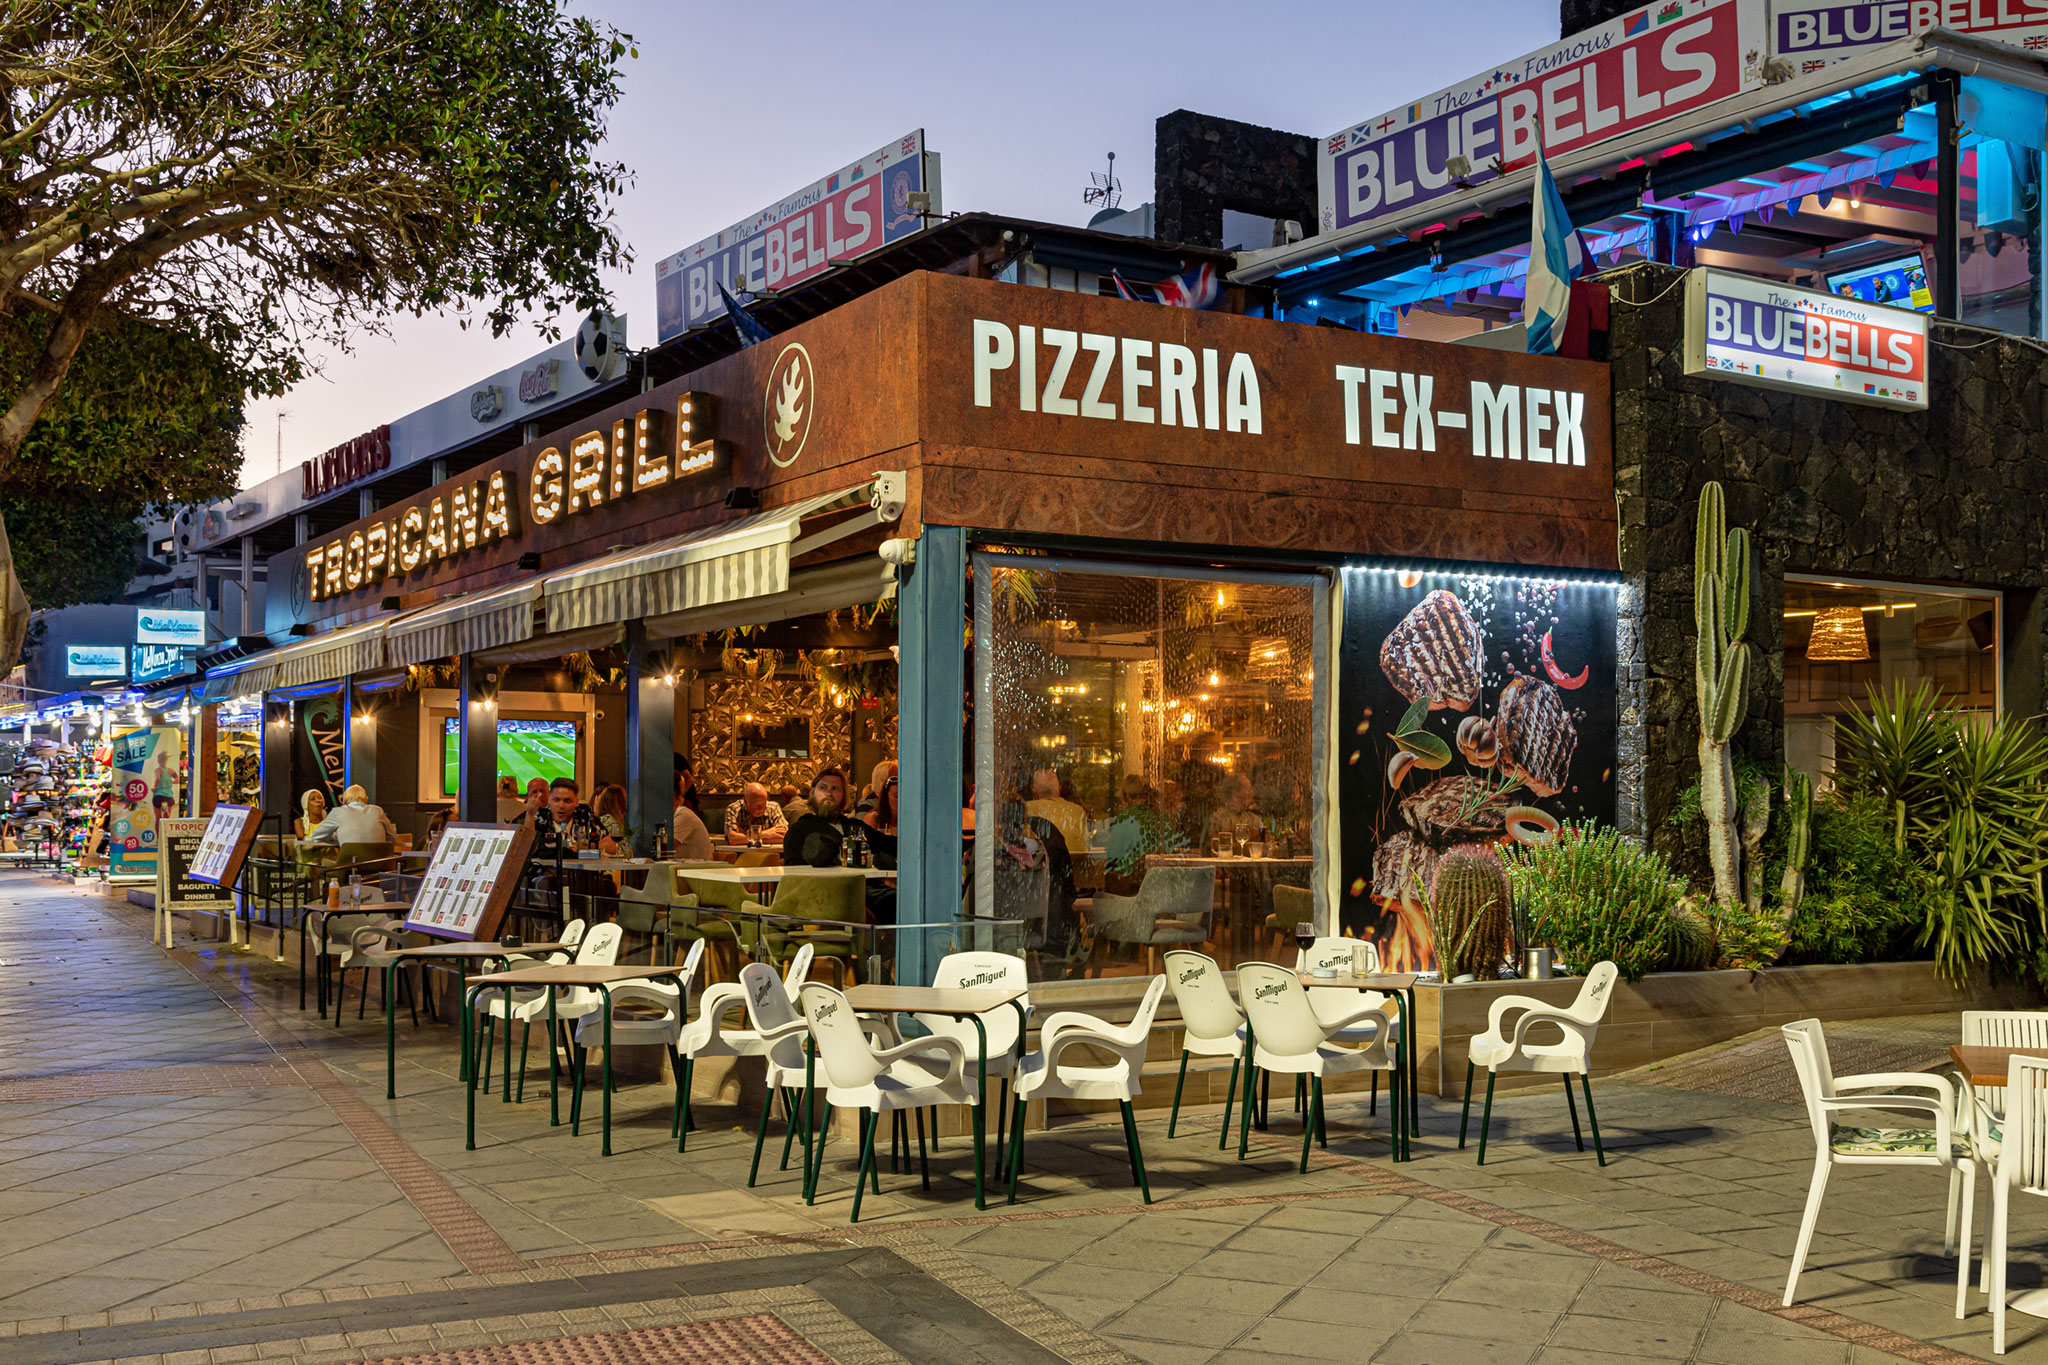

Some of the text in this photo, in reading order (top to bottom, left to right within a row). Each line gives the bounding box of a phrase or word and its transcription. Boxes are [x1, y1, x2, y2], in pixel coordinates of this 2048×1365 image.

[1433, 29, 1615, 116] The Famous
[1347, 16, 1717, 218] BLUEBELLS
[731, 188, 823, 245] The Famous
[689, 184, 872, 321] BLUEBELLS
[1767, 292, 1868, 323] The Famous
[1708, 297, 1913, 374] BLUEBELLS
[973, 318, 1262, 435] PIZZERIA
[1335, 364, 1586, 467] TEX-MEX
[306, 390, 715, 601] TROPICANA GRILL
[116, 737, 146, 751] SUPER
[116, 746, 146, 763] SALE
[129, 783, 145, 793] 50
[117, 822, 128, 830] 30
[126, 839, 137, 847] 20
[1179, 964, 1206, 984] SanMiguel
[1318, 954, 1353, 969] SanMigu
[958, 966, 1007, 989] SanMiguel
[1255, 980, 1288, 999] SanMiguel
